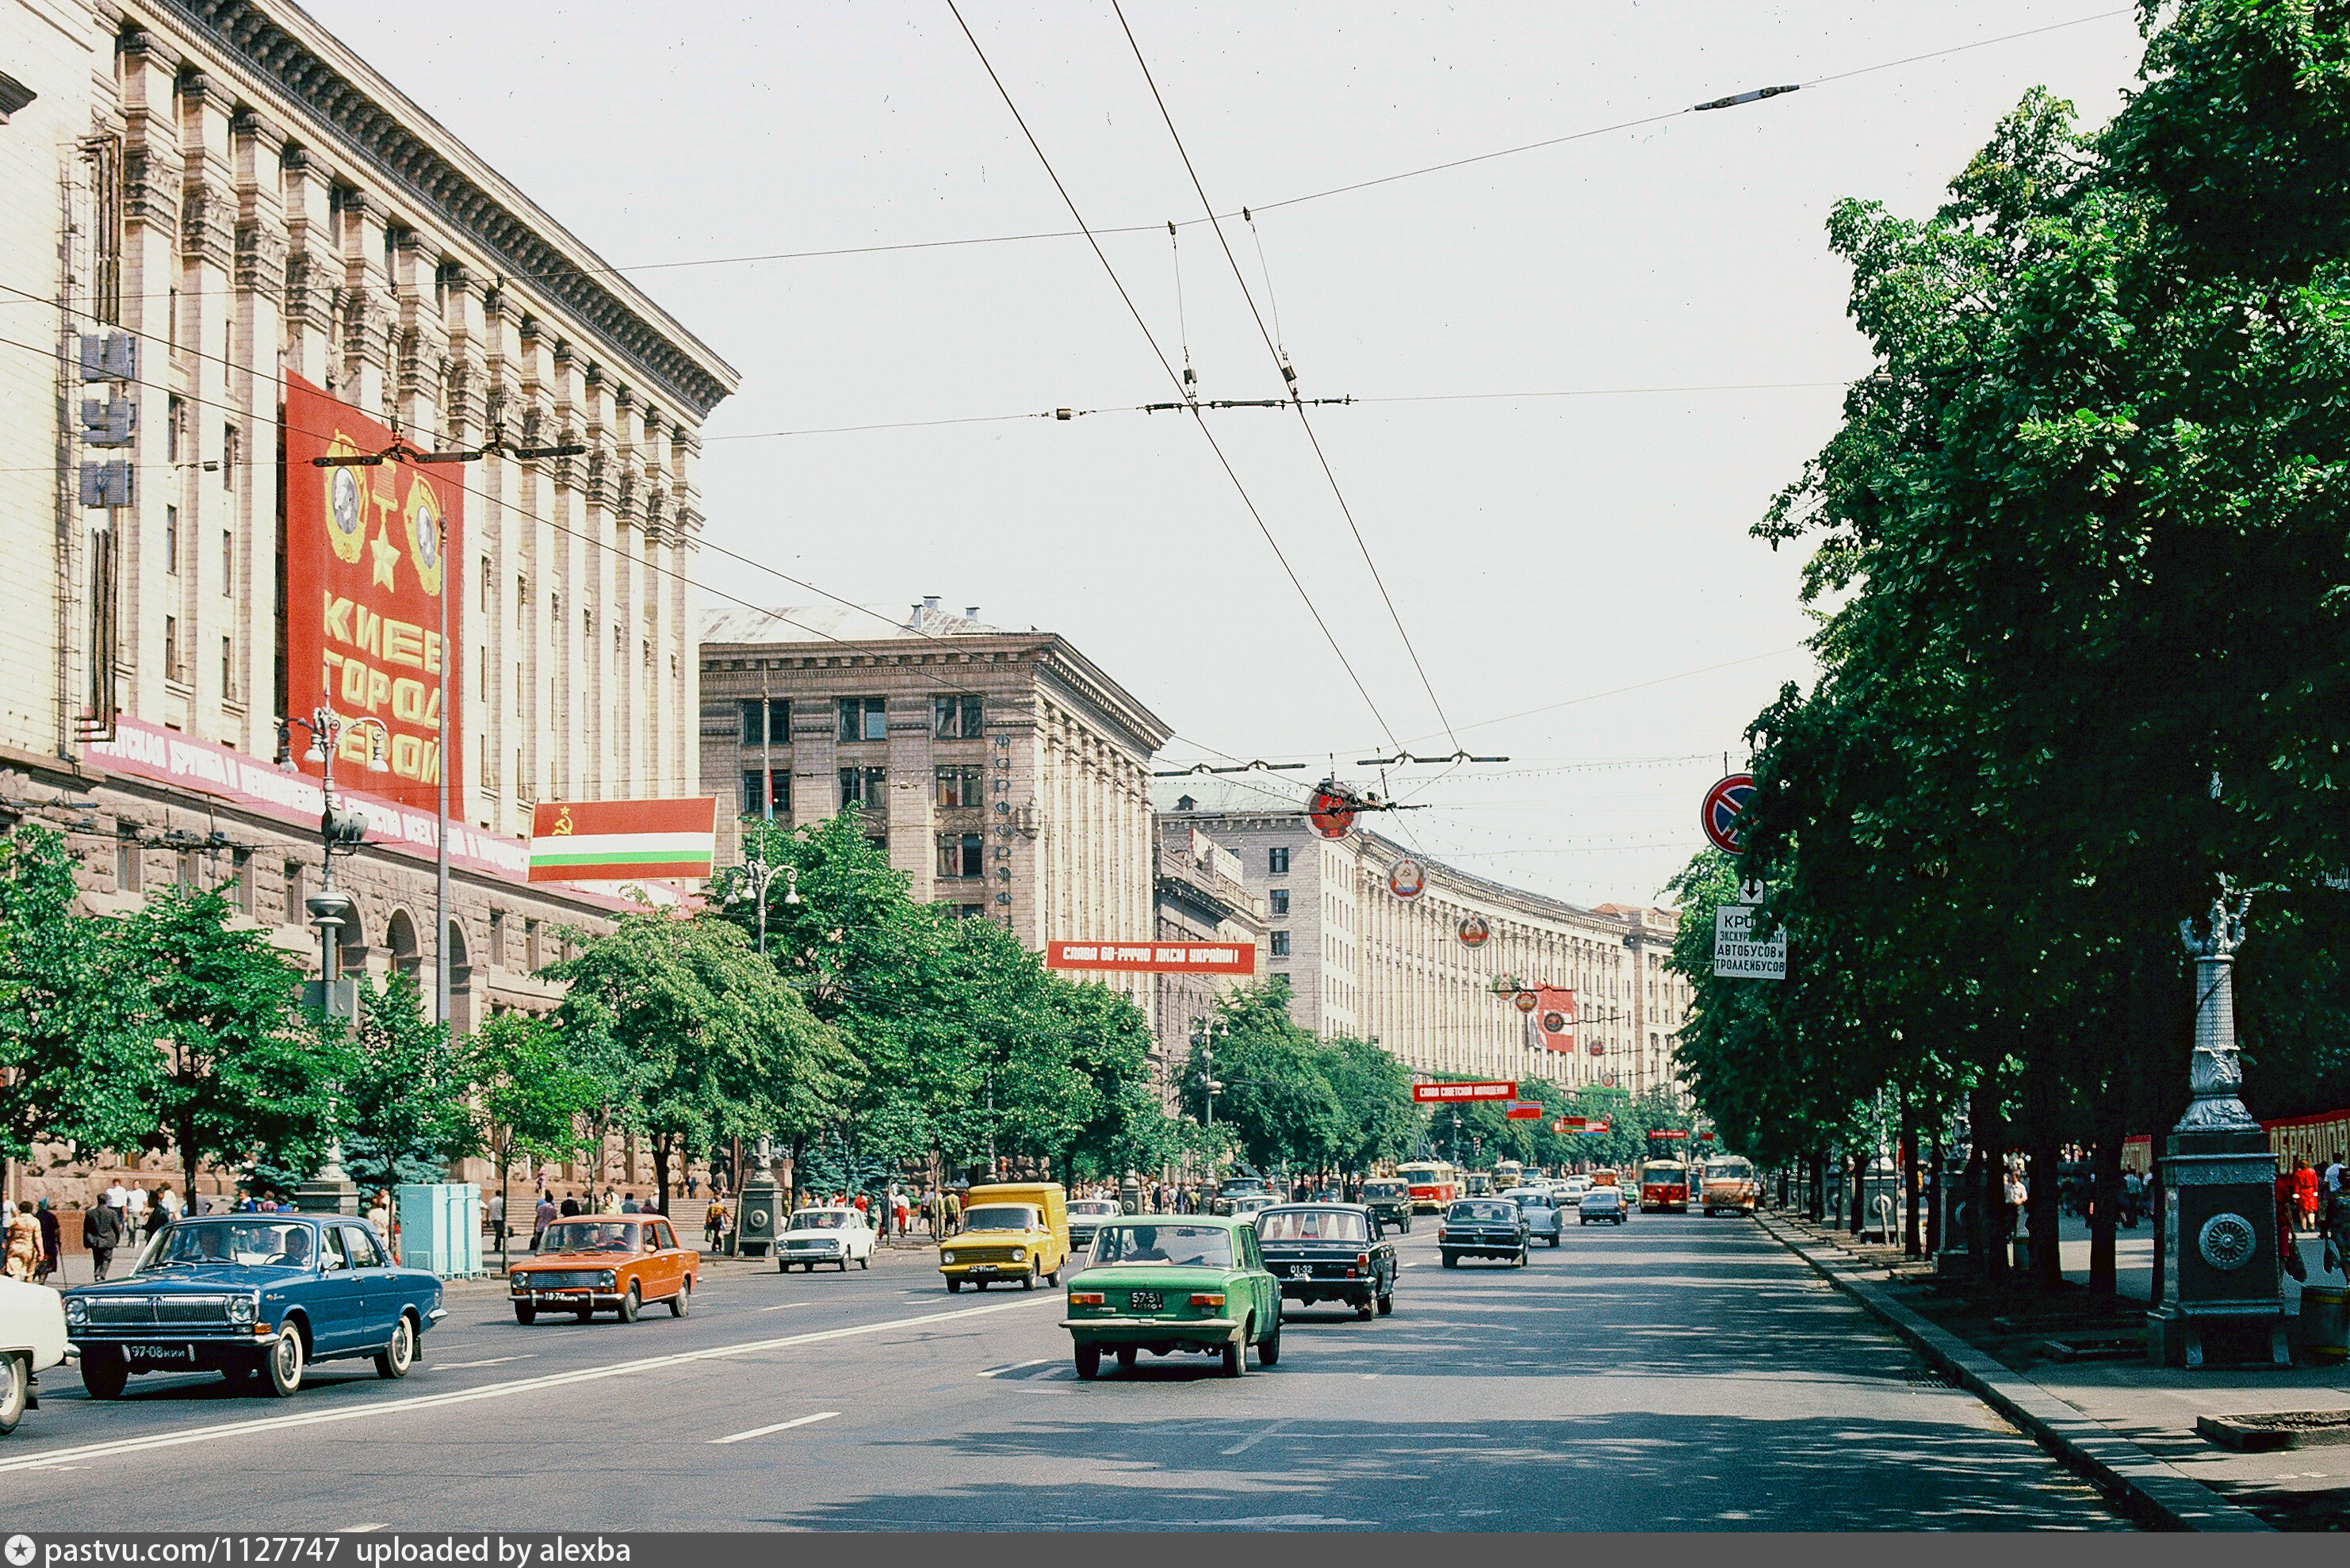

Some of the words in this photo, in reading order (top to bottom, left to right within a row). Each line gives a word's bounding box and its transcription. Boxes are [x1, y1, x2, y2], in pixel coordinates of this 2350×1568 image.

[323, 590, 450, 676] КИЕВ
[329, 708, 442, 786] ЕРОЙ
[1724, 915, 1755, 928] КРО
[1719, 931, 1784, 944] ЭКСКУРЫХ
[1062, 946, 1098, 962] СЛАВА
[1155, 947, 1186, 963] ЛКСМ
[1717, 945, 1776, 958] АВТОБУСОВ
[1715, 959, 1785, 972] ТРОЛЛЕЙБУСОВ
